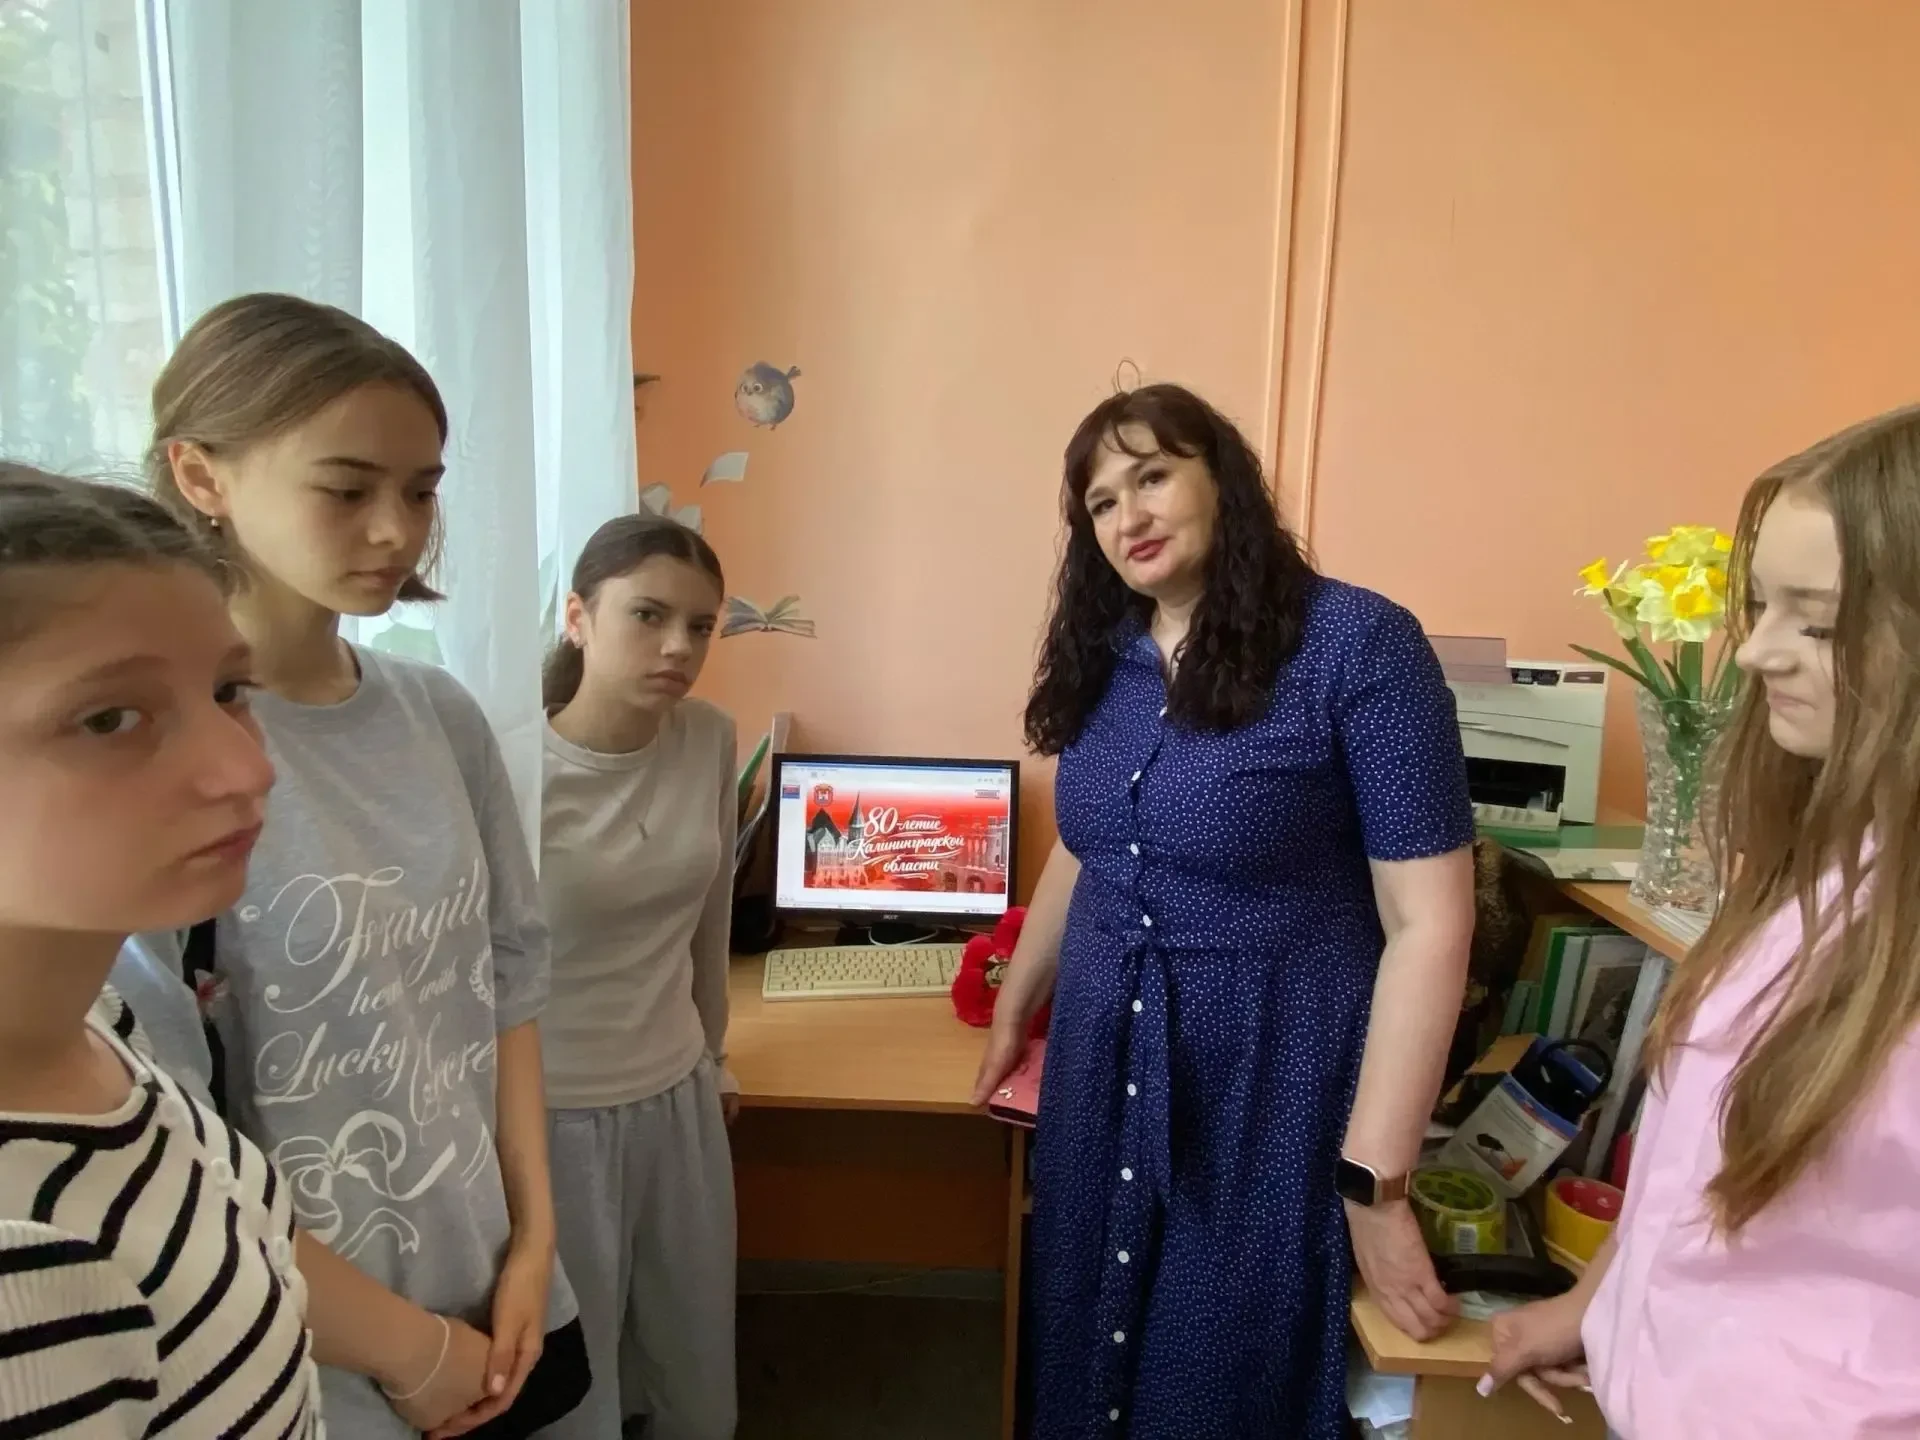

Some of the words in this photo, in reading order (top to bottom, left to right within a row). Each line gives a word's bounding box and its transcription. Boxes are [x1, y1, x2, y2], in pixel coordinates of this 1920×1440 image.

[864, 807, 943, 837] 80-летие
[846, 833, 965, 860] Калининградской
[883, 855, 941, 873] области
[255, 1021, 407, 1106] Lucky
